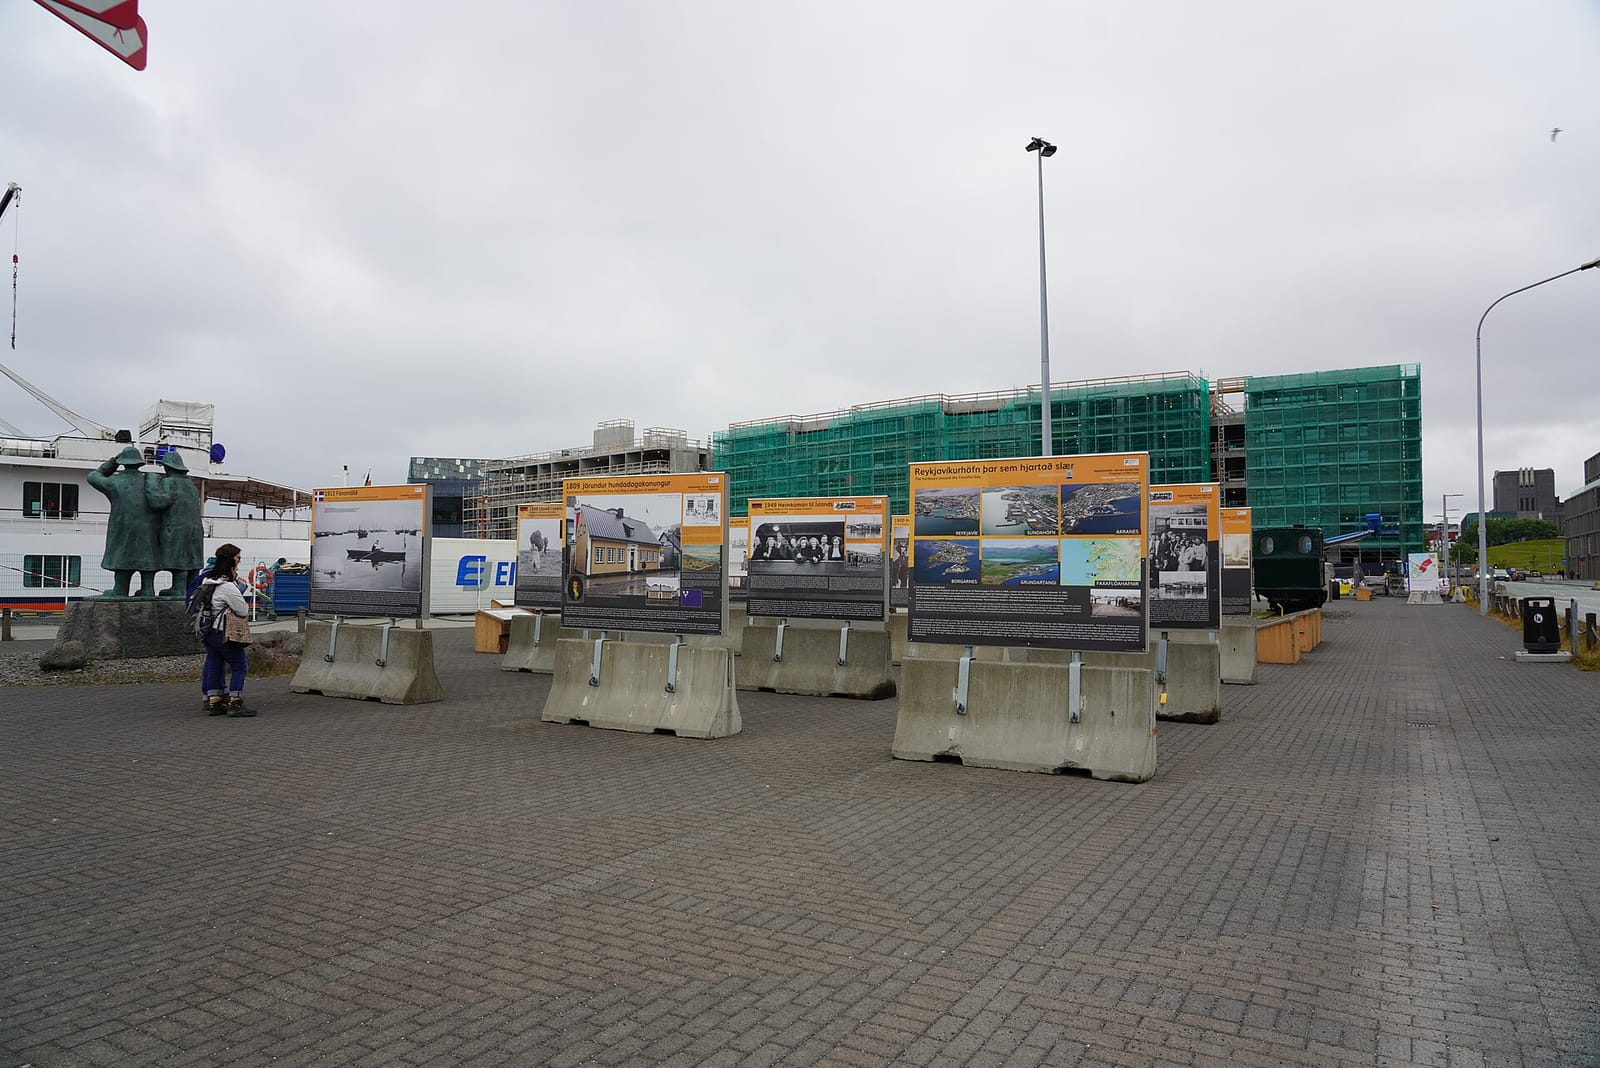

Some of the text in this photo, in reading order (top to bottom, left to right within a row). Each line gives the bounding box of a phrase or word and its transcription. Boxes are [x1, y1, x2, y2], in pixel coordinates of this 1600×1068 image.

[999, 465, 1018, 473] sem
[1020, 462, 1053, 473] hjartað
[1055, 462, 1075, 470] slær
[565, 480, 672, 490] 1809 Jörundur hundadagakonungur
